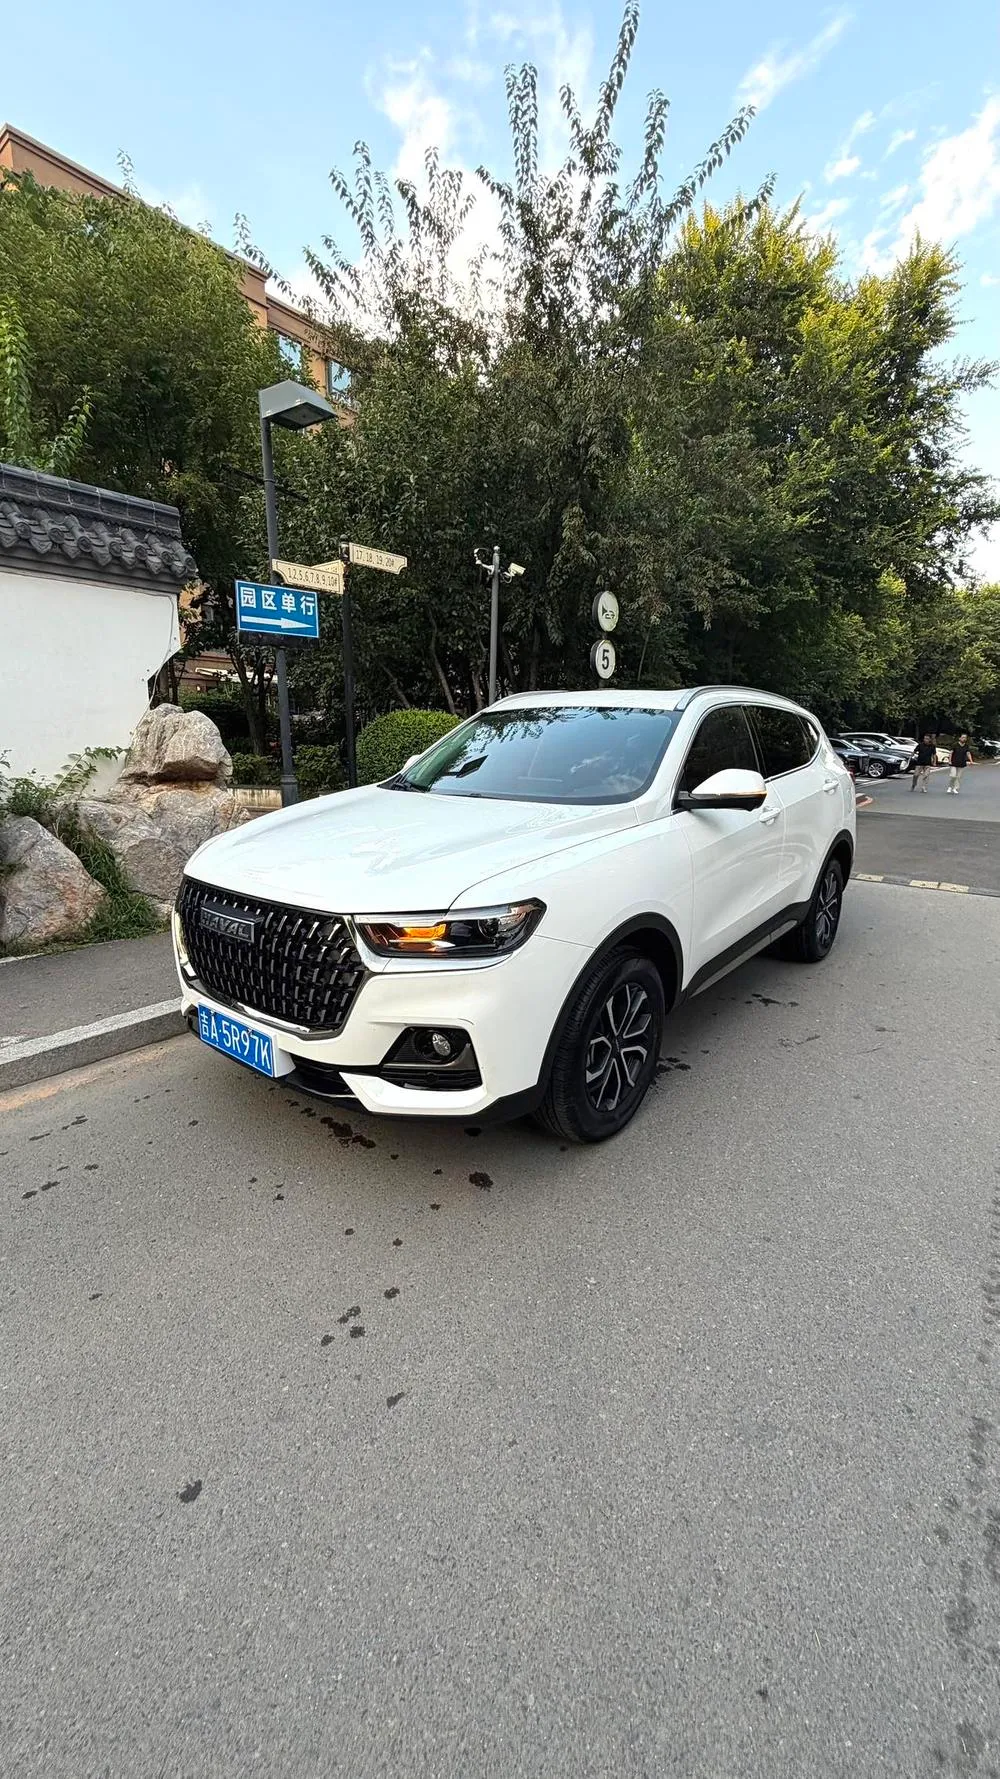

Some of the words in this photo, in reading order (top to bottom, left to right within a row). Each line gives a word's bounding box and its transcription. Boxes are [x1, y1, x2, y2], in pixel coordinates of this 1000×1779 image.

[240, 587, 315, 615] 园区单行
[602, 649, 609, 670] 5
[201, 911, 249, 938] HAVAL
